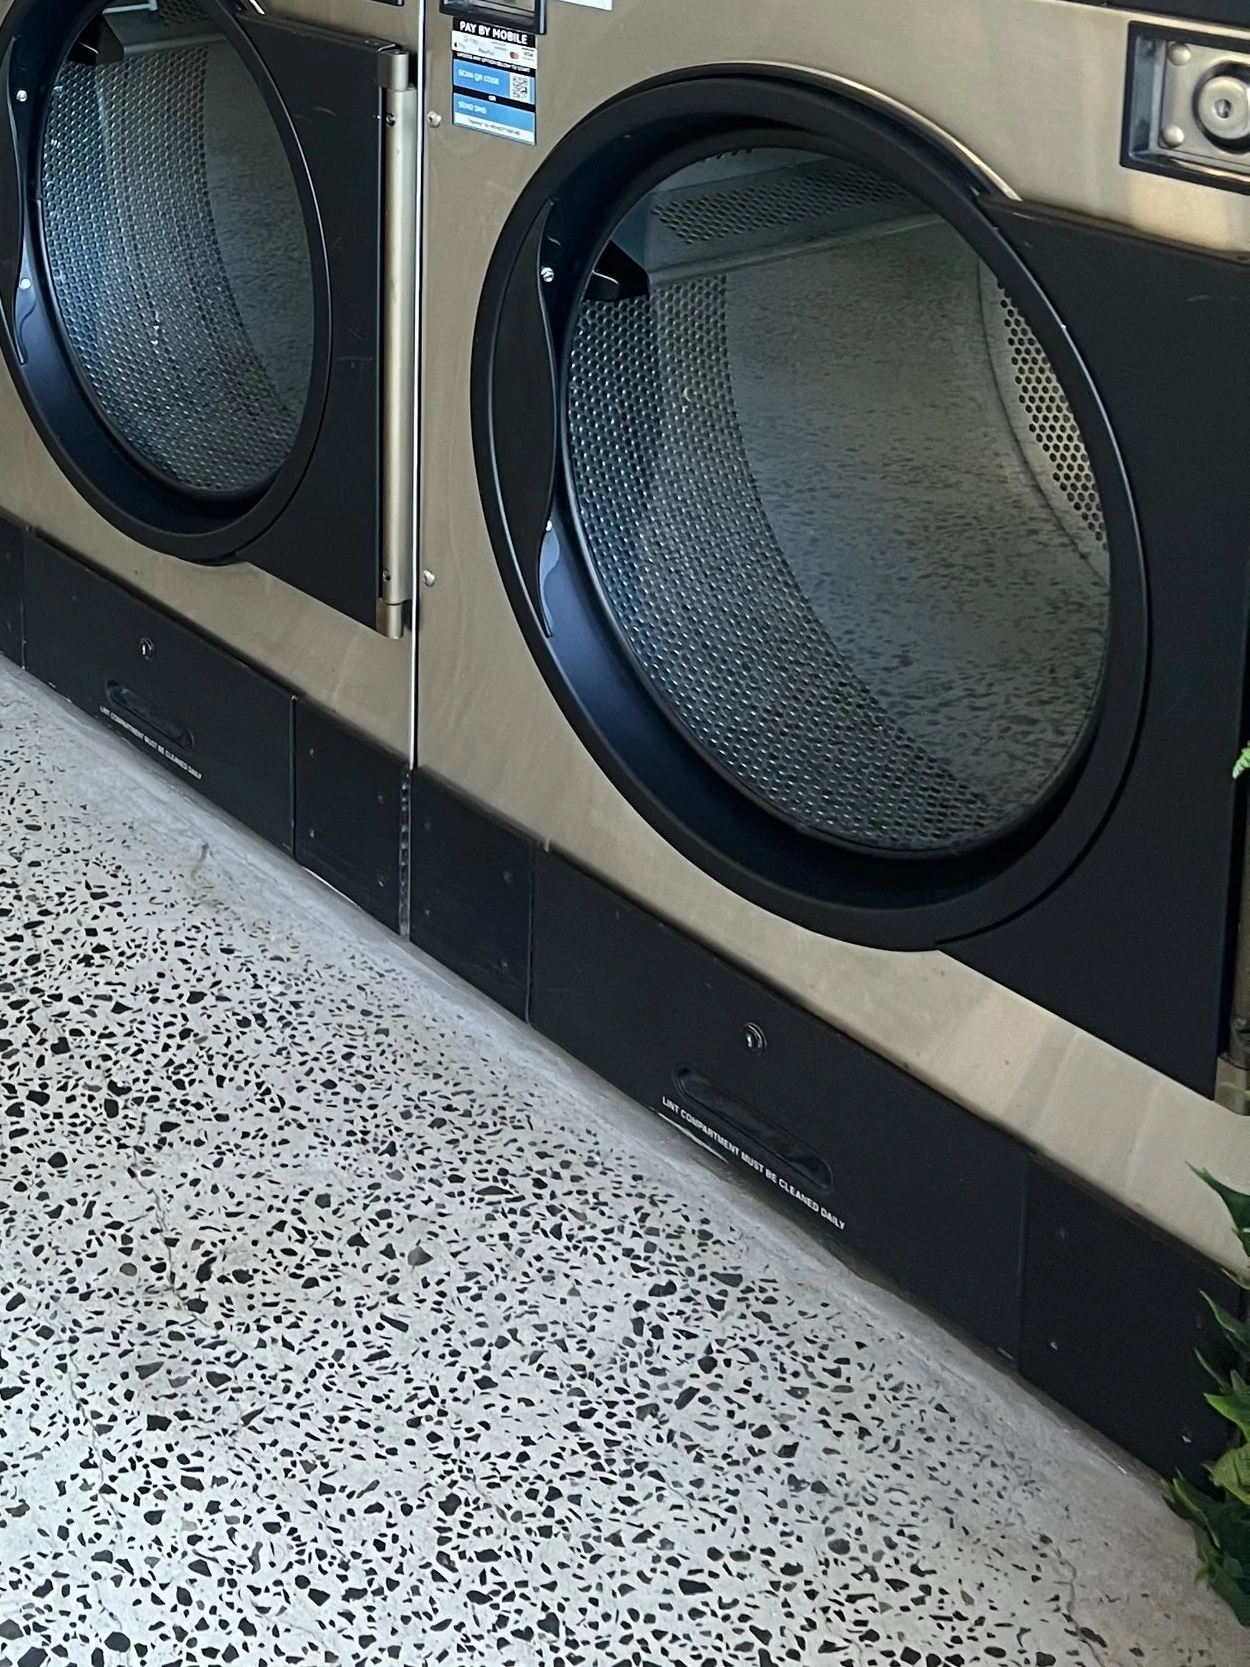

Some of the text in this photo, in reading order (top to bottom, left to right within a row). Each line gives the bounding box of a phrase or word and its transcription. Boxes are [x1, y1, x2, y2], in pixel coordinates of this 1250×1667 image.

[459, 20, 528, 45] PAY BY MOBILE
[458, 69, 499, 86] SCAN QR CODE
[662, 1096, 846, 1230] LINT COMPARTMENT MUST BE CLEANED DAILY
